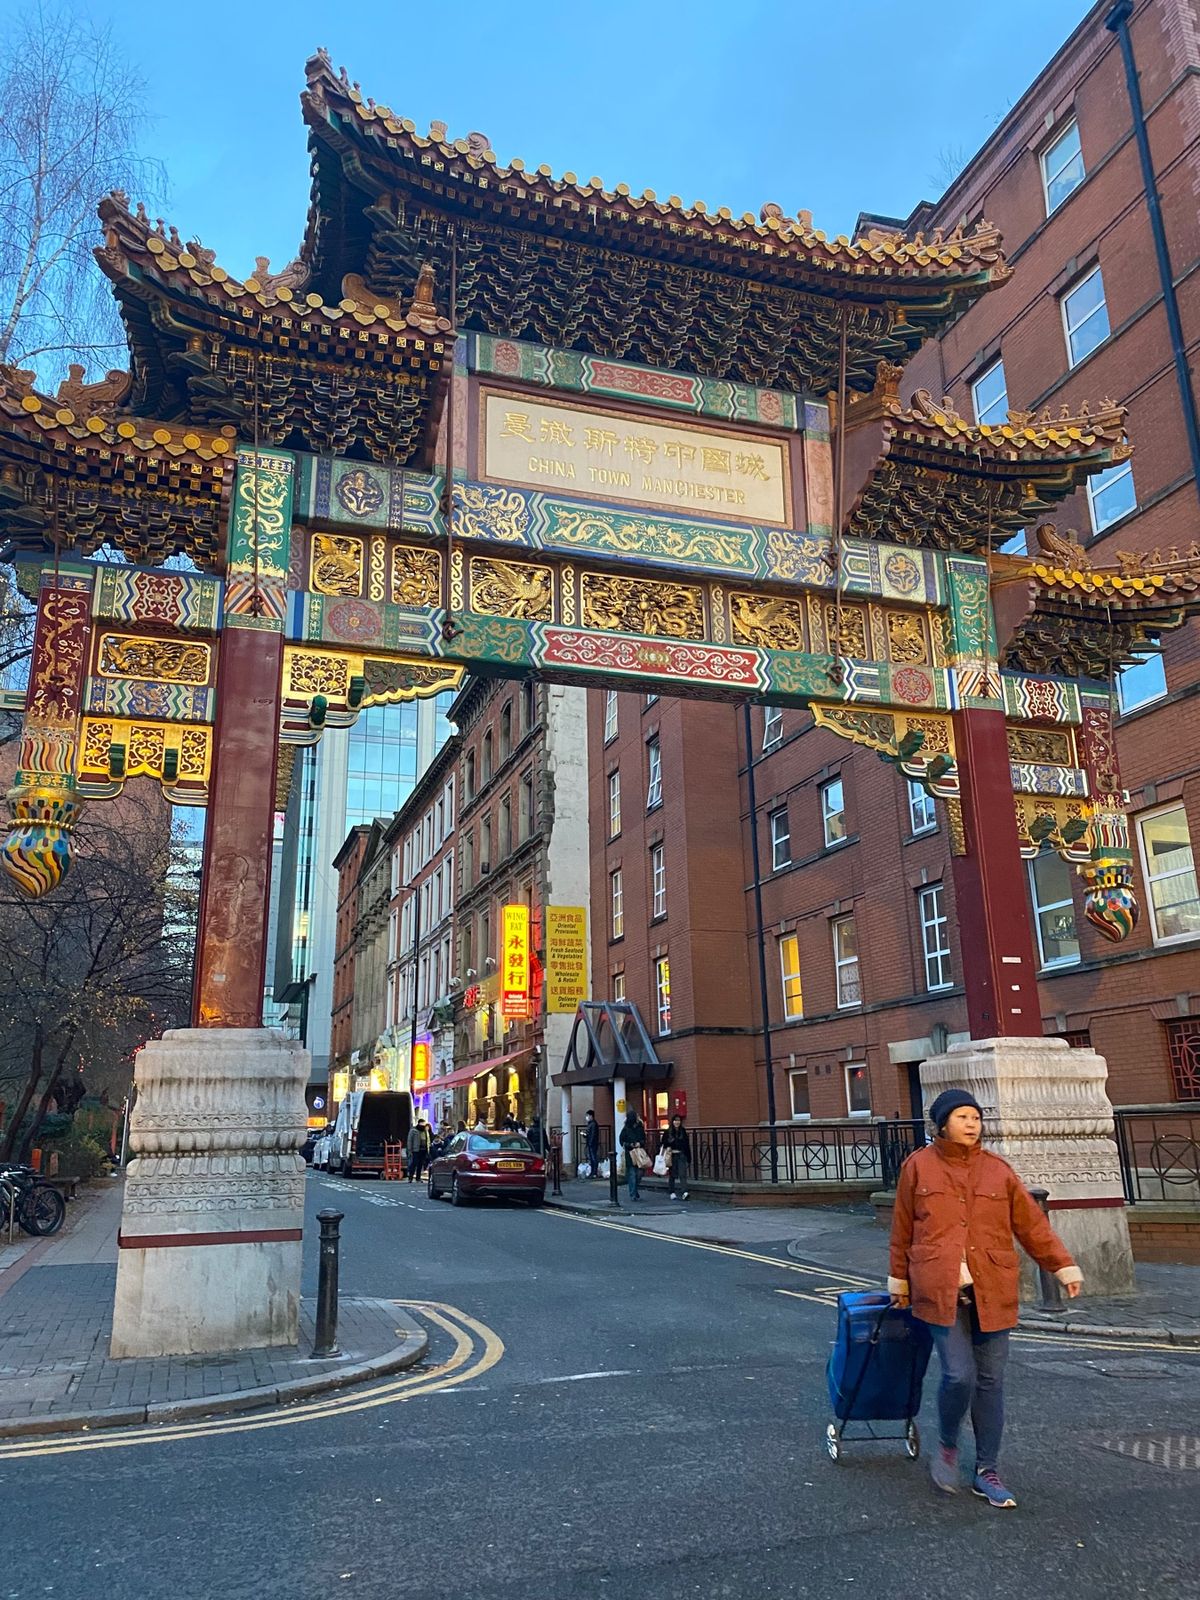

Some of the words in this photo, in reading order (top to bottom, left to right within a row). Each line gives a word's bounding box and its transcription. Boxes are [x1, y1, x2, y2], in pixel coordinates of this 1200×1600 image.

[528, 456, 576, 479] CHINA
[588, 467, 632, 487] TOWN
[641, 475, 746, 505] MANCHESTER
[506, 912, 526, 920] WING
[550, 914, 582, 922] 亞洲食品
[510, 922, 523, 931] FAT
[508, 935, 525, 985] 永發行
